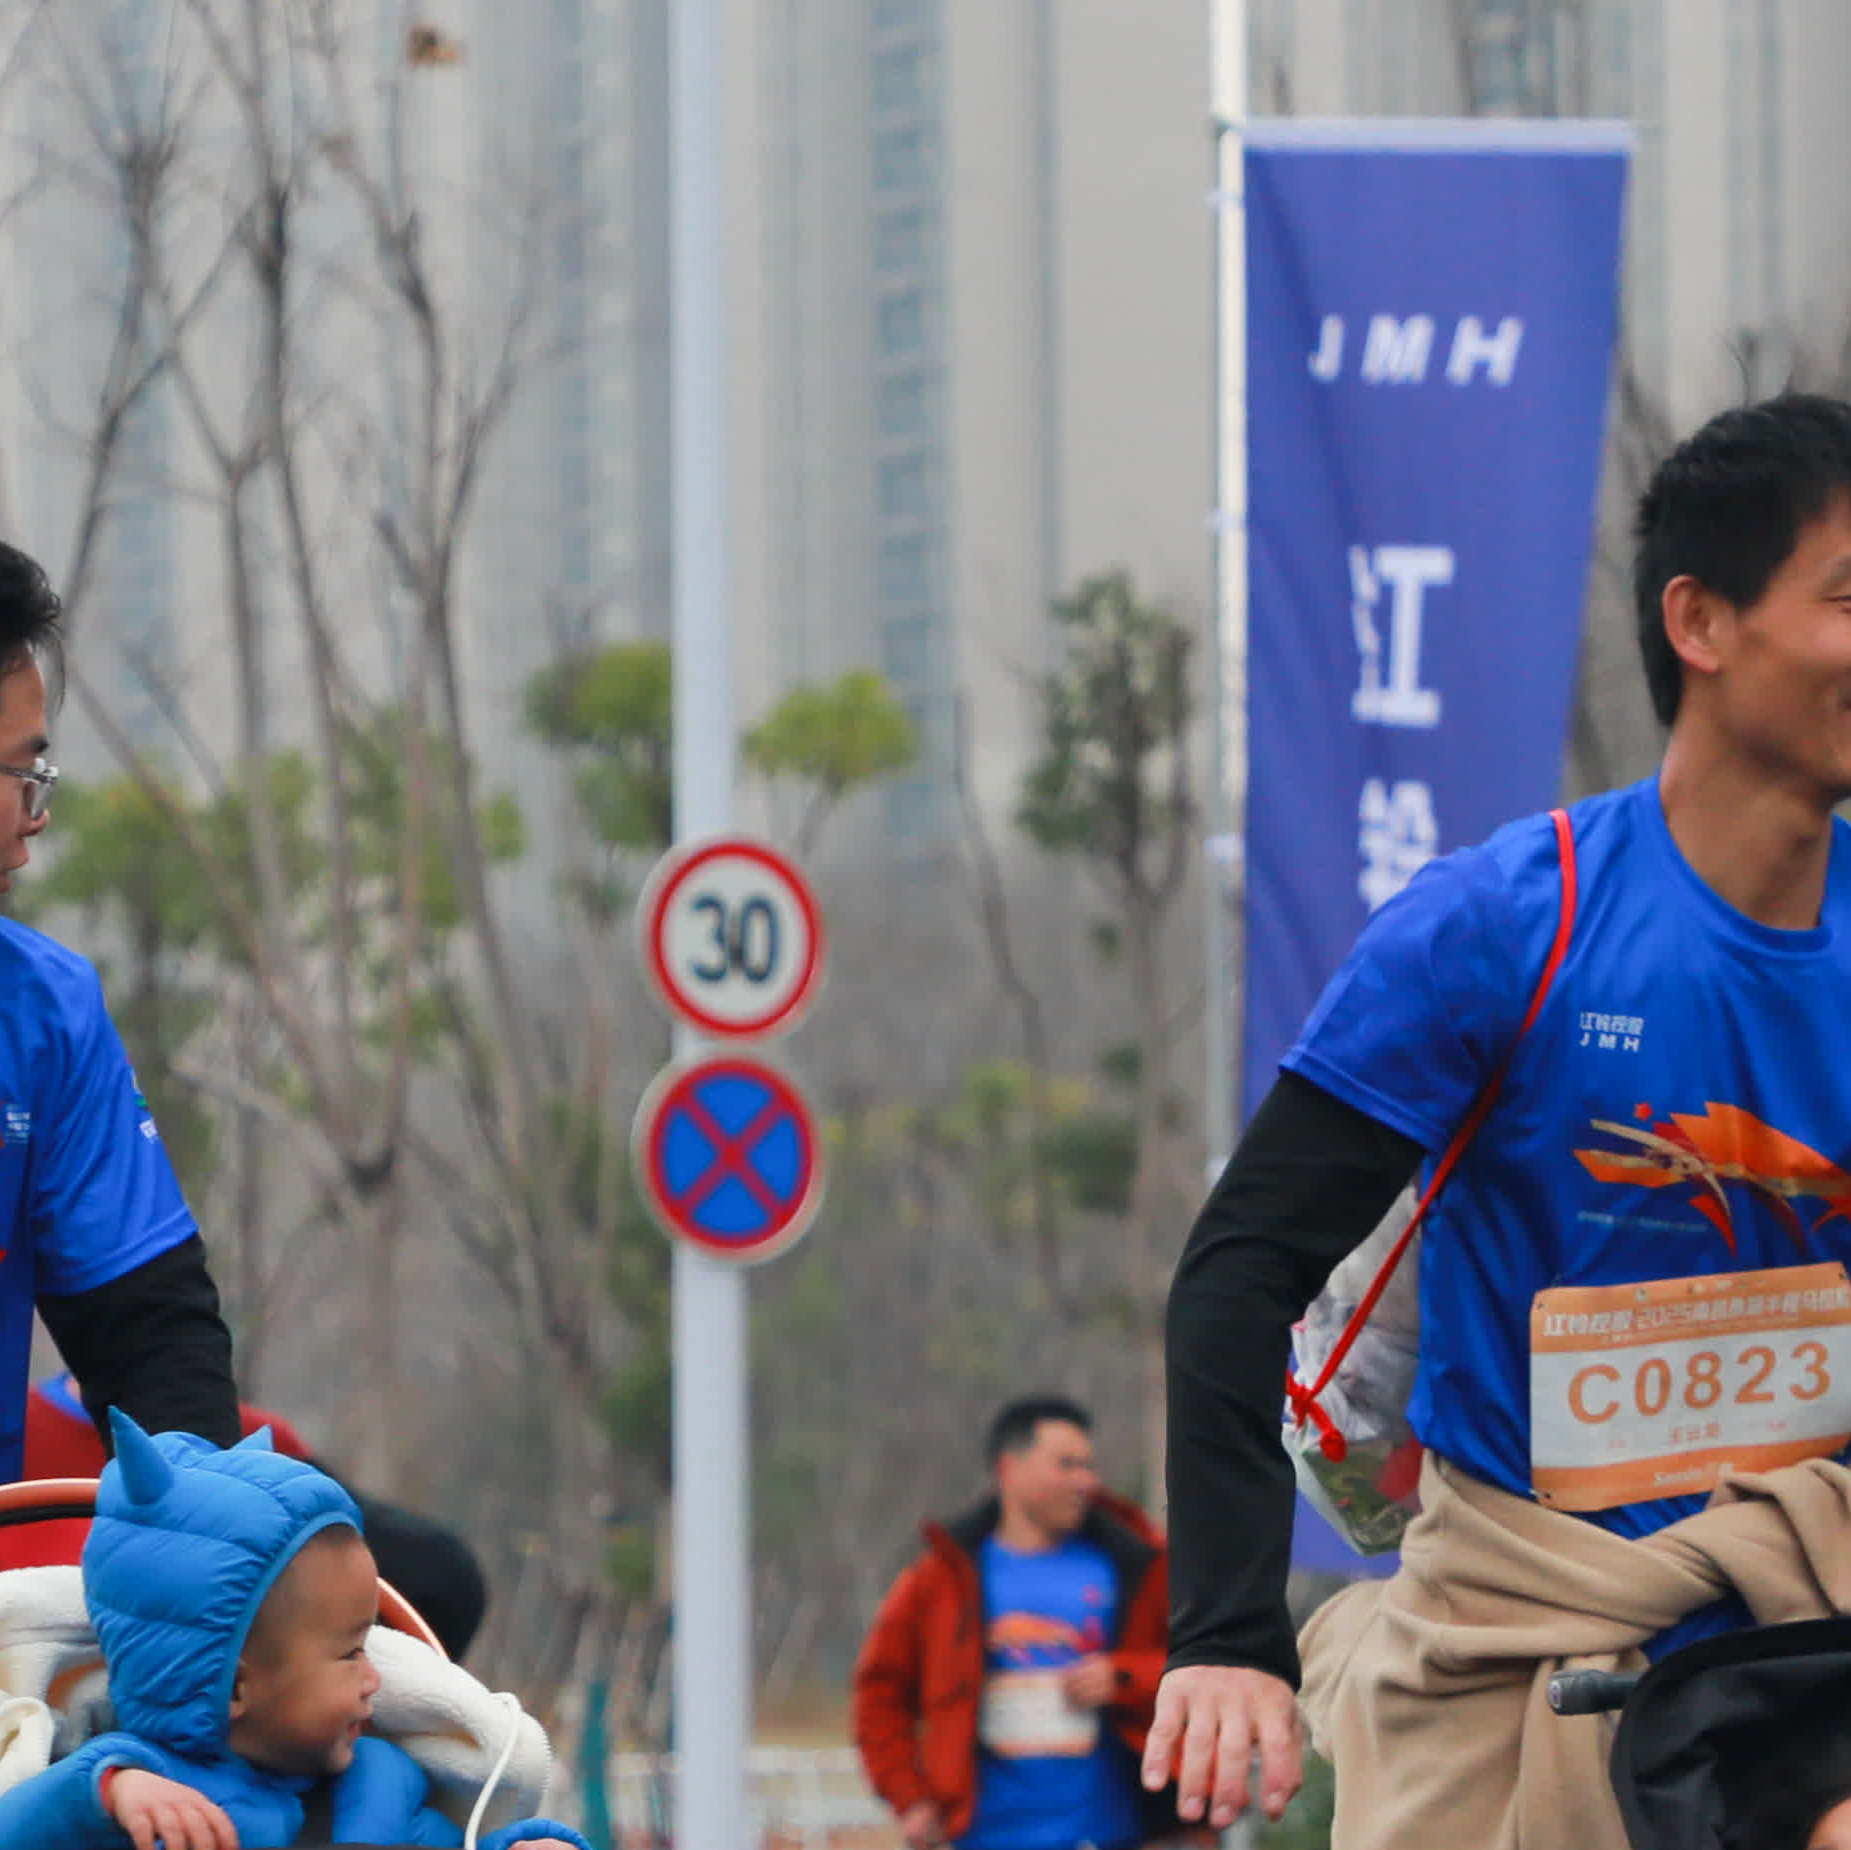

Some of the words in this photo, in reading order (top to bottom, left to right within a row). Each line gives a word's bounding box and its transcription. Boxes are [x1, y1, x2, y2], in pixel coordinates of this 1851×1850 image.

[1308, 313, 1525, 387] JMH
[689, 893, 782, 986] 30
[1579, 1033, 1641, 1053] JMH
[1568, 1341, 1831, 1424] C0823
